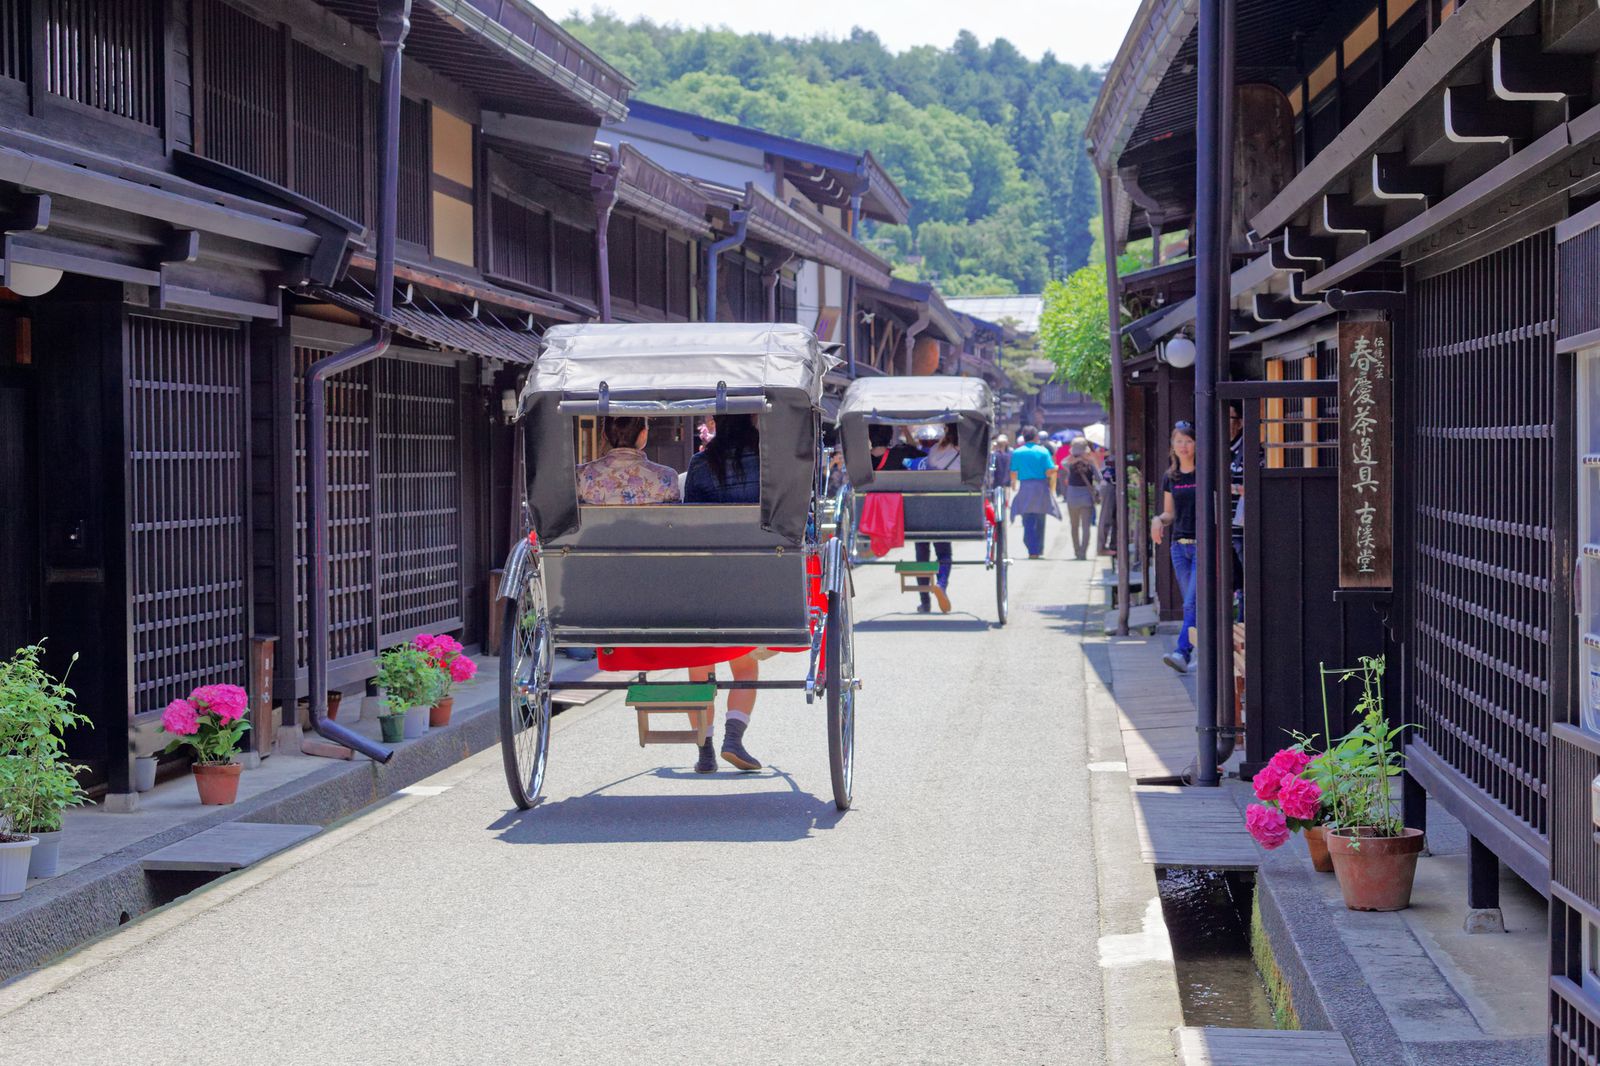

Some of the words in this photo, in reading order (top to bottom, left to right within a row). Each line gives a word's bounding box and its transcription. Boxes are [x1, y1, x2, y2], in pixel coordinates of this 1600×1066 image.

[1350, 335, 1379, 493] 春慶茶道具
